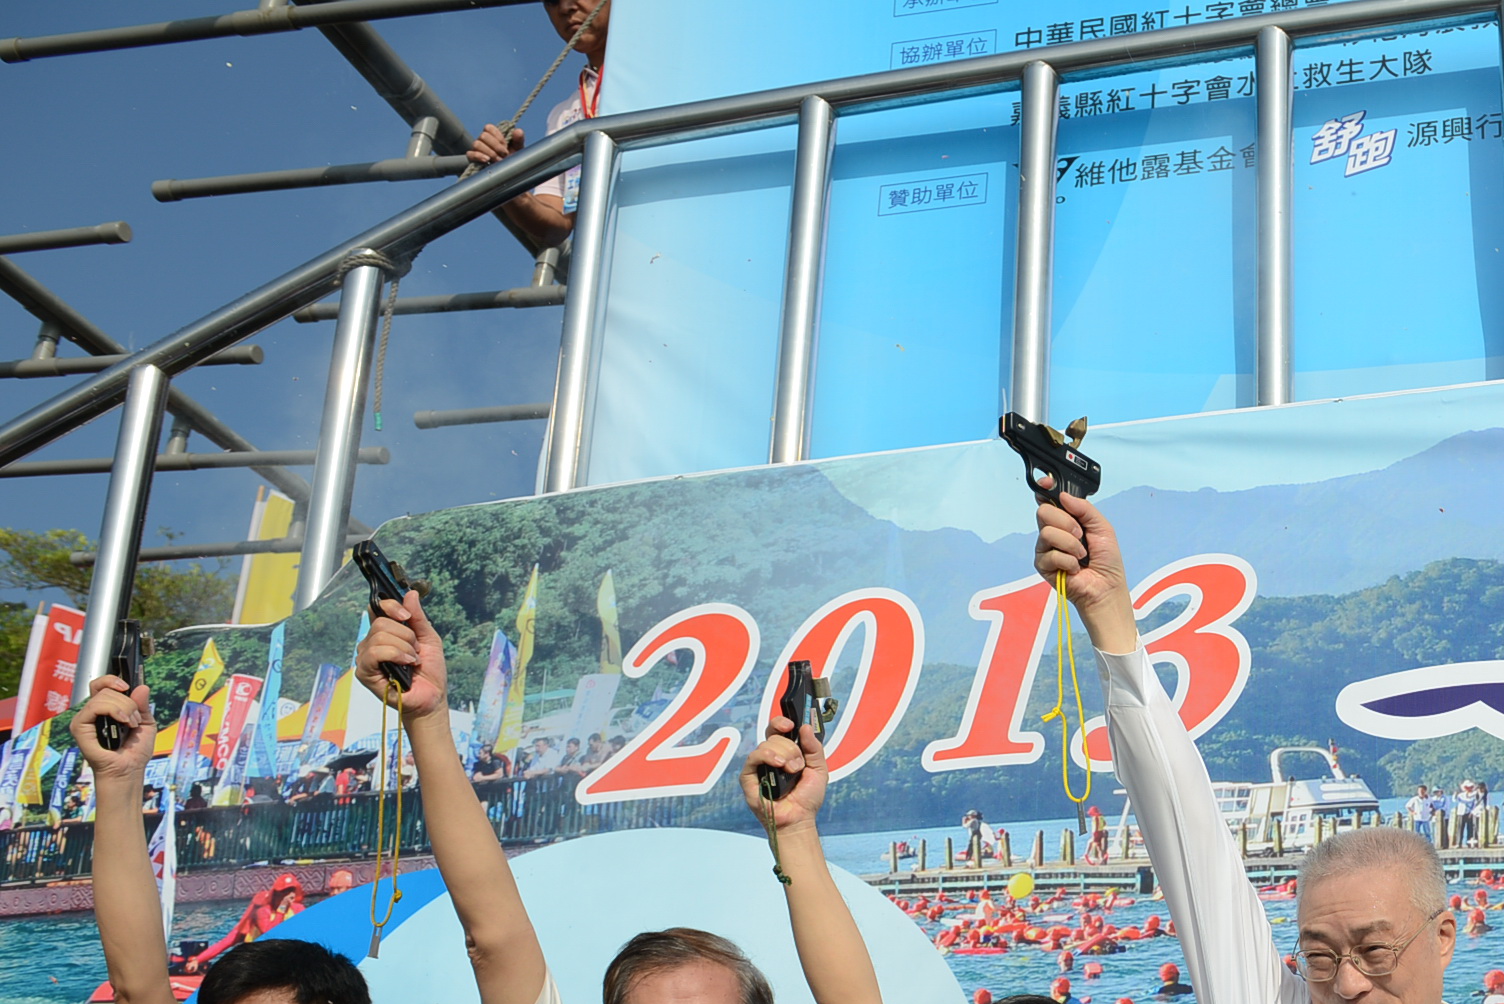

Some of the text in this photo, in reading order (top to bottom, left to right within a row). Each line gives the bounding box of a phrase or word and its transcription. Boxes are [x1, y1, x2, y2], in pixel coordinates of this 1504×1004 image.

[1015, 0, 1330, 49] 中華民國紅十字會
[900, 37, 988, 65] 協辦單位
[1309, 109, 1399, 178] 舒跑
[888, 180, 980, 209] 贊助單位
[576, 554, 1256, 804] 2013
